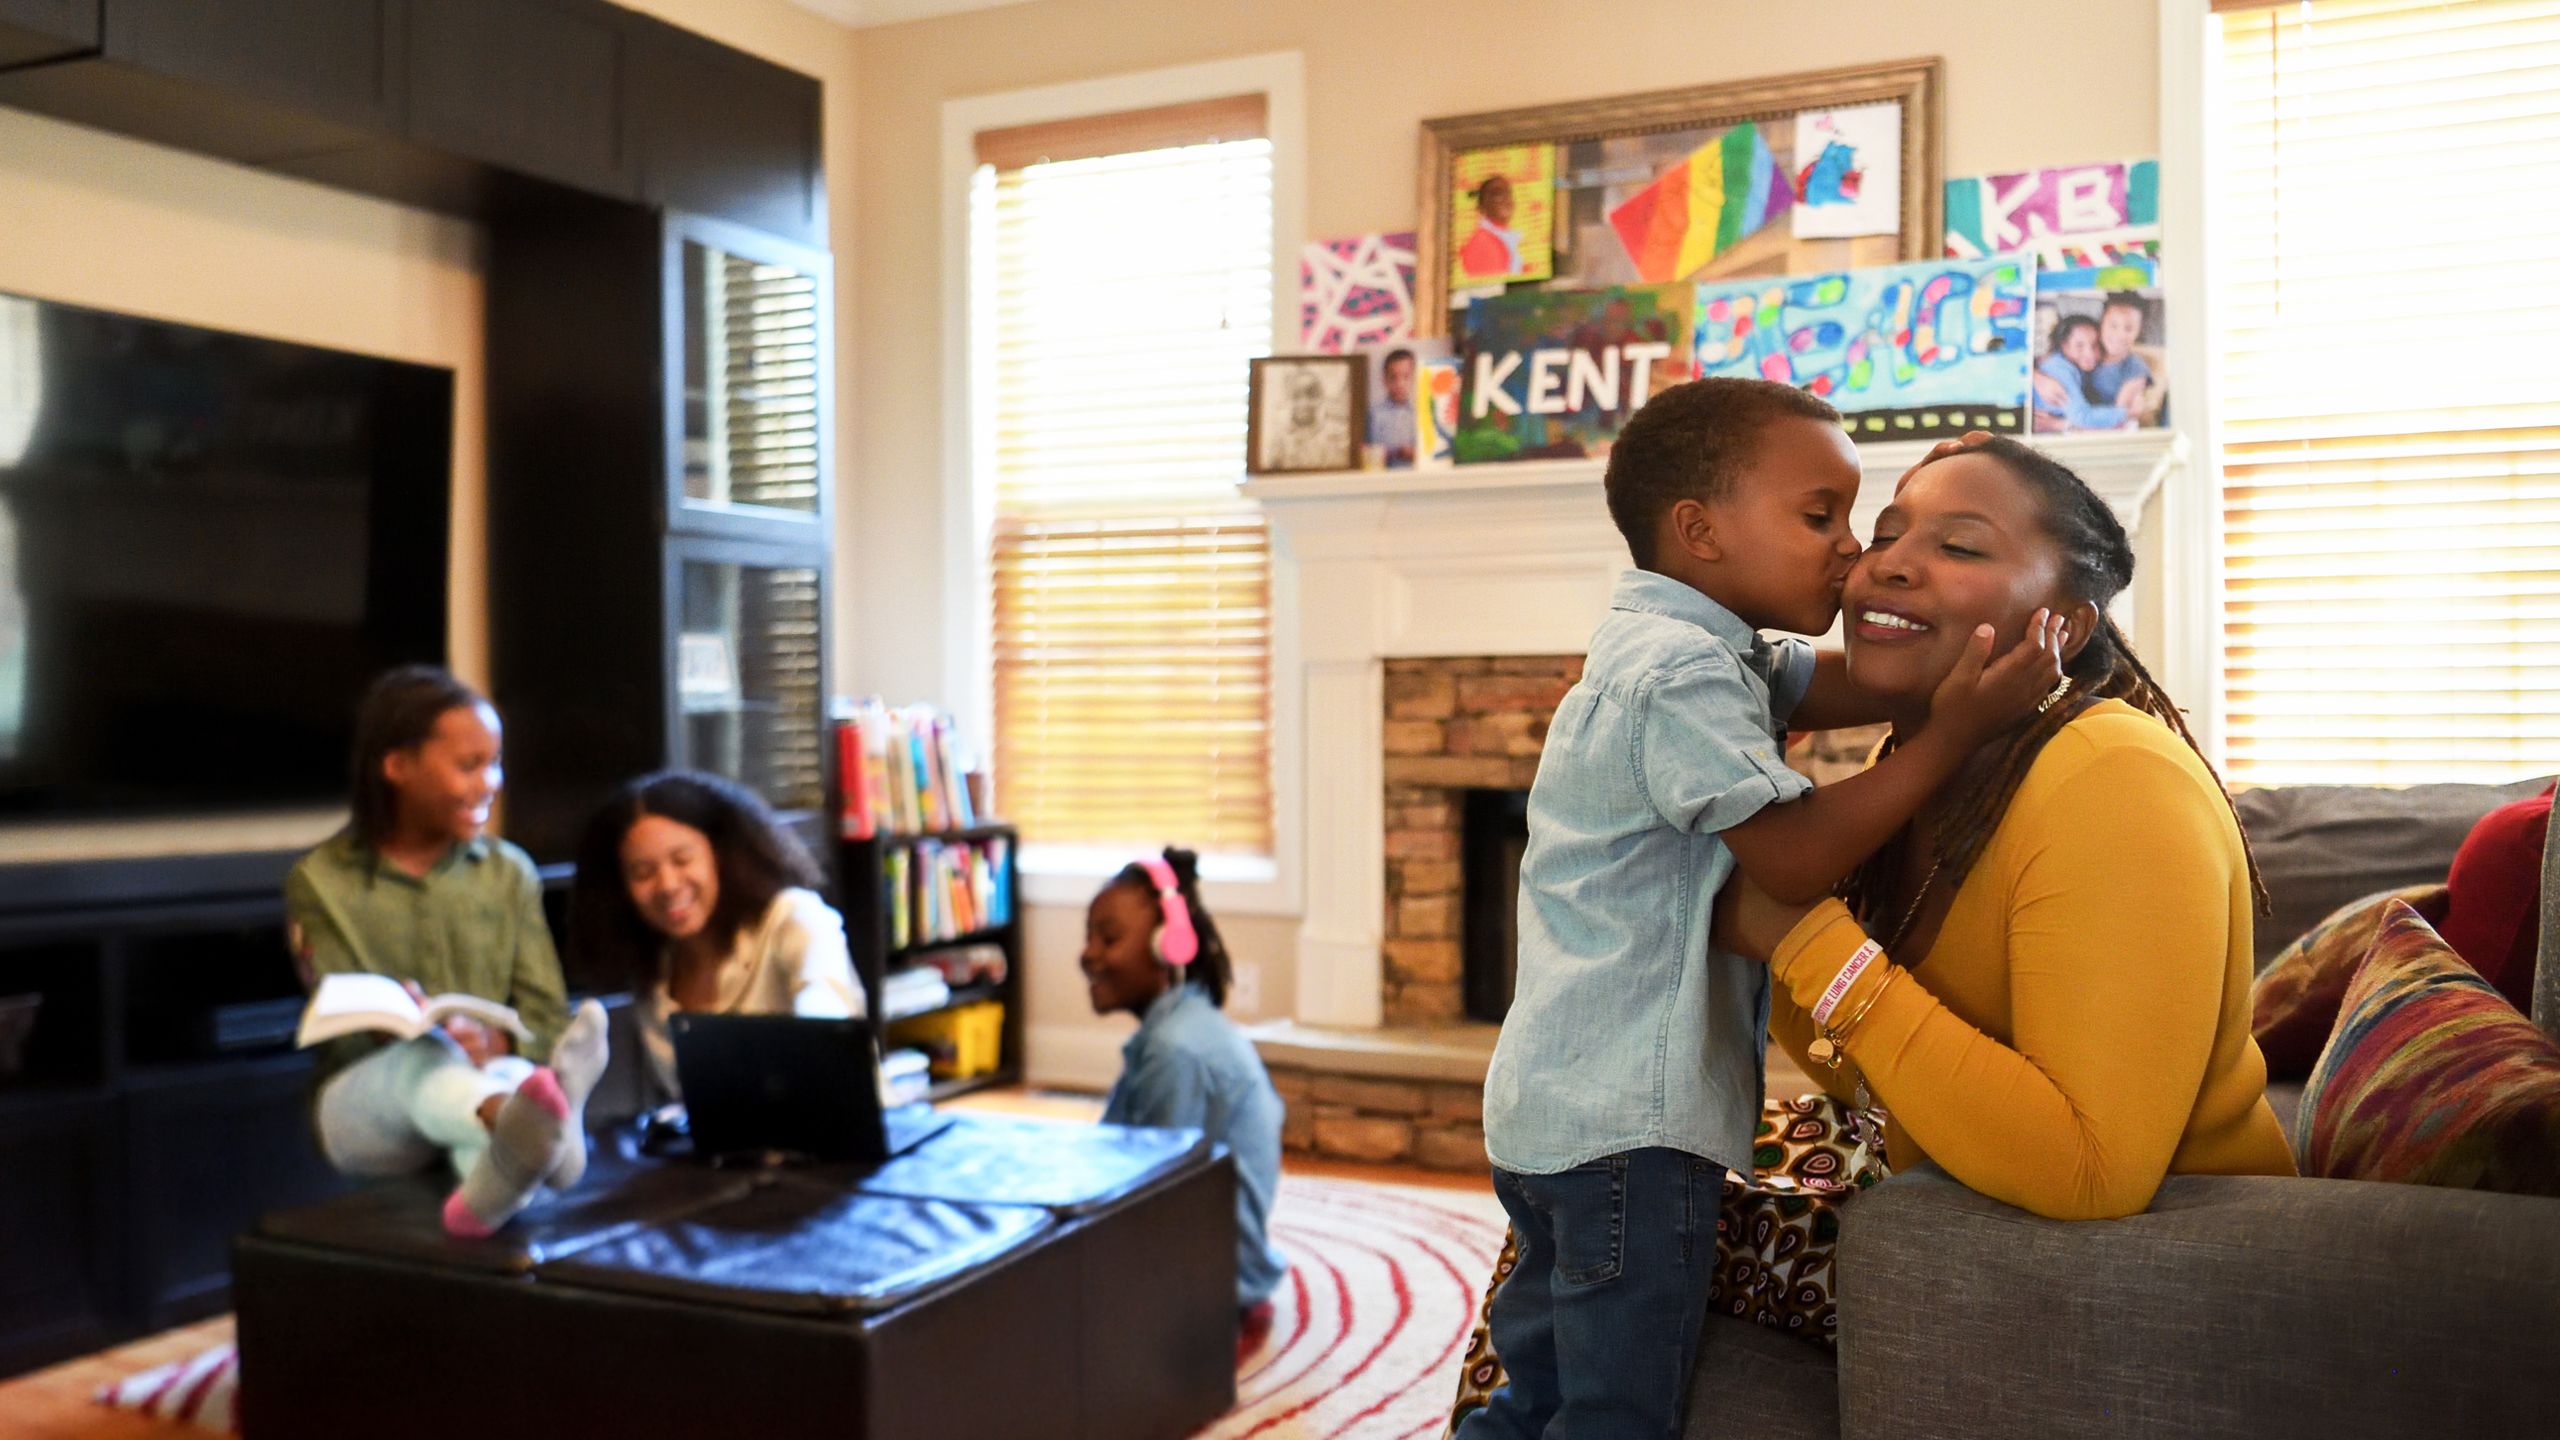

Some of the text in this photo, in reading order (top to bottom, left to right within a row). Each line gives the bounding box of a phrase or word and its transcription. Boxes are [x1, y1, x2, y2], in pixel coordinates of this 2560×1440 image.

[1692, 265, 2028, 397] PEACE
[1472, 341, 1671, 418] KENT
[1828, 977, 1848, 1000] LUNG
[1842, 951, 1870, 981] CANCER
